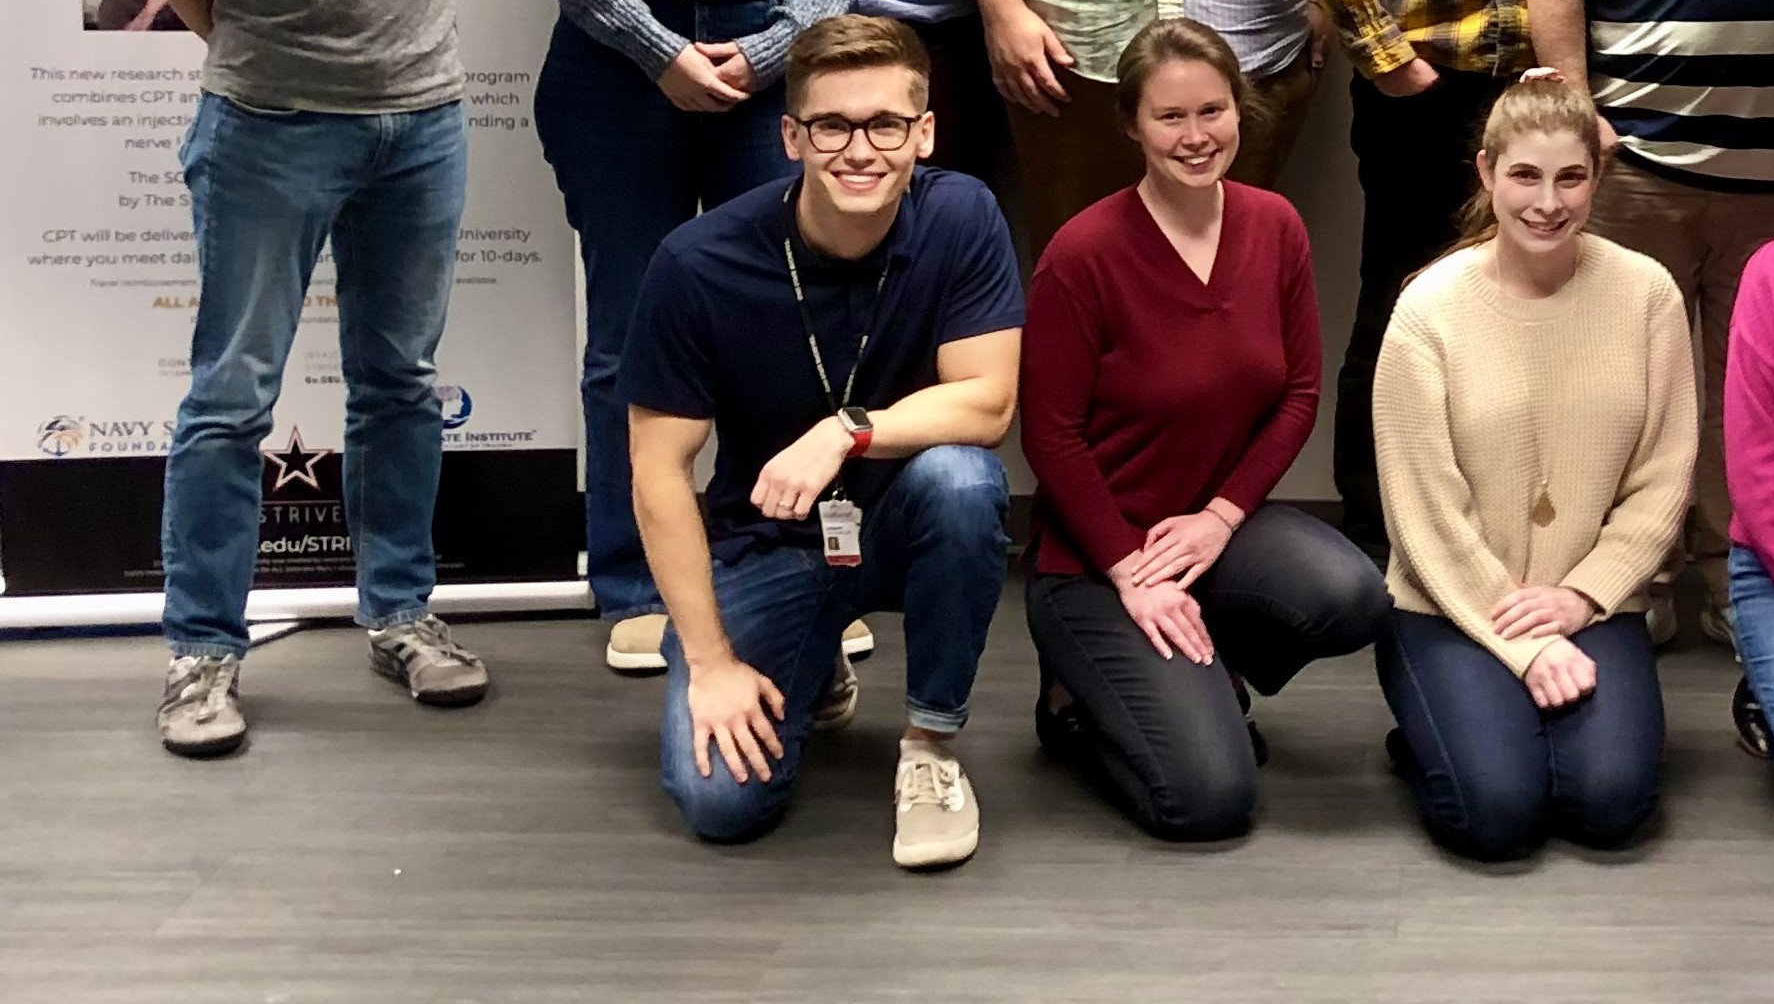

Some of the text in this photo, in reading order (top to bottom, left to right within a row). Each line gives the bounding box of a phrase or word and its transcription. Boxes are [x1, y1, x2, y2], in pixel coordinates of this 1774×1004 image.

[31, 67, 66, 81] This
[69, 68, 105, 81] new
[110, 68, 184, 81] research
[51, 90, 137, 104] combines
[140, 90, 175, 104] CPT
[470, 91, 520, 106] which
[38, 114, 107, 127] involves
[111, 116, 133, 127] an
[519, 117, 529, 128] a
[124, 138, 171, 149] nerve
[128, 171, 159, 184] The
[118, 195, 139, 210] by
[144, 194, 175, 207] The
[41, 229, 77, 243] CPT
[80, 229, 111, 243] will
[115, 229, 137, 242] be
[27, 252, 82, 266] where
[85, 254, 118, 268] you
[122, 252, 167, 265] meet
[455, 250, 476, 263] for
[480, 250, 543, 265] 10-days.
[152, 297, 184, 309] ALL
[89, 421, 154, 436] NAVY
[466, 431, 534, 443] INSTITUTE
[259, 506, 342, 524] STRIVE
